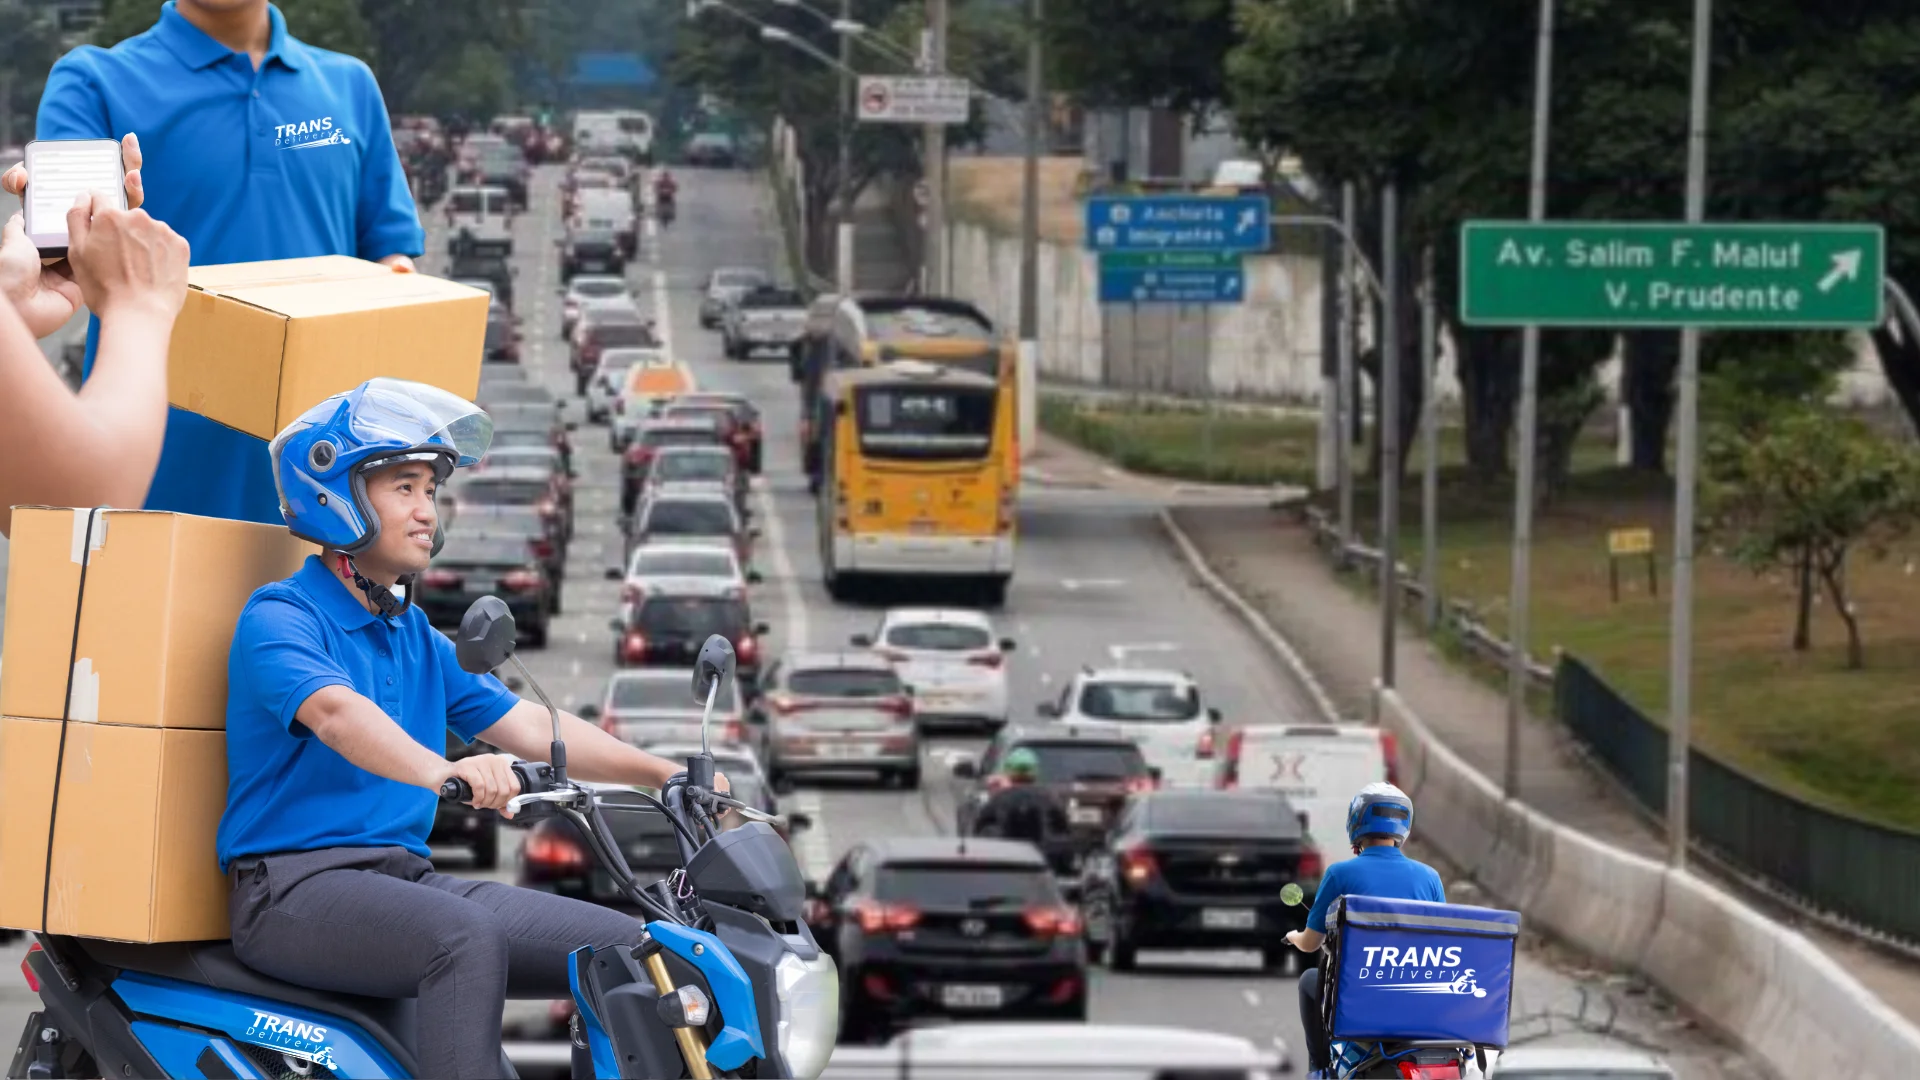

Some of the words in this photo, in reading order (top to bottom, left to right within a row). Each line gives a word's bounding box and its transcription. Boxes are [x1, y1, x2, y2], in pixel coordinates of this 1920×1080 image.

[274, 117, 333, 138] TRANS
[274, 131, 333, 146] Delivery
[1143, 204, 1224, 221] Anchieta
[1128, 227, 1225, 246] Imigrantes
[1496, 240, 1553, 267] Av.
[1565, 240, 1654, 268] Salim
[1671, 241, 1701, 268] F.
[1712, 241, 1802, 268] Maluf
[1605, 283, 1638, 310] V.
[1648, 284, 1801, 311] Prudente
[1363, 946, 1462, 967] TRANS
[1359, 968, 1460, 982] Delivery
[252, 1012, 327, 1043] TRANS
[246, 1026, 321, 1053] Delivery
